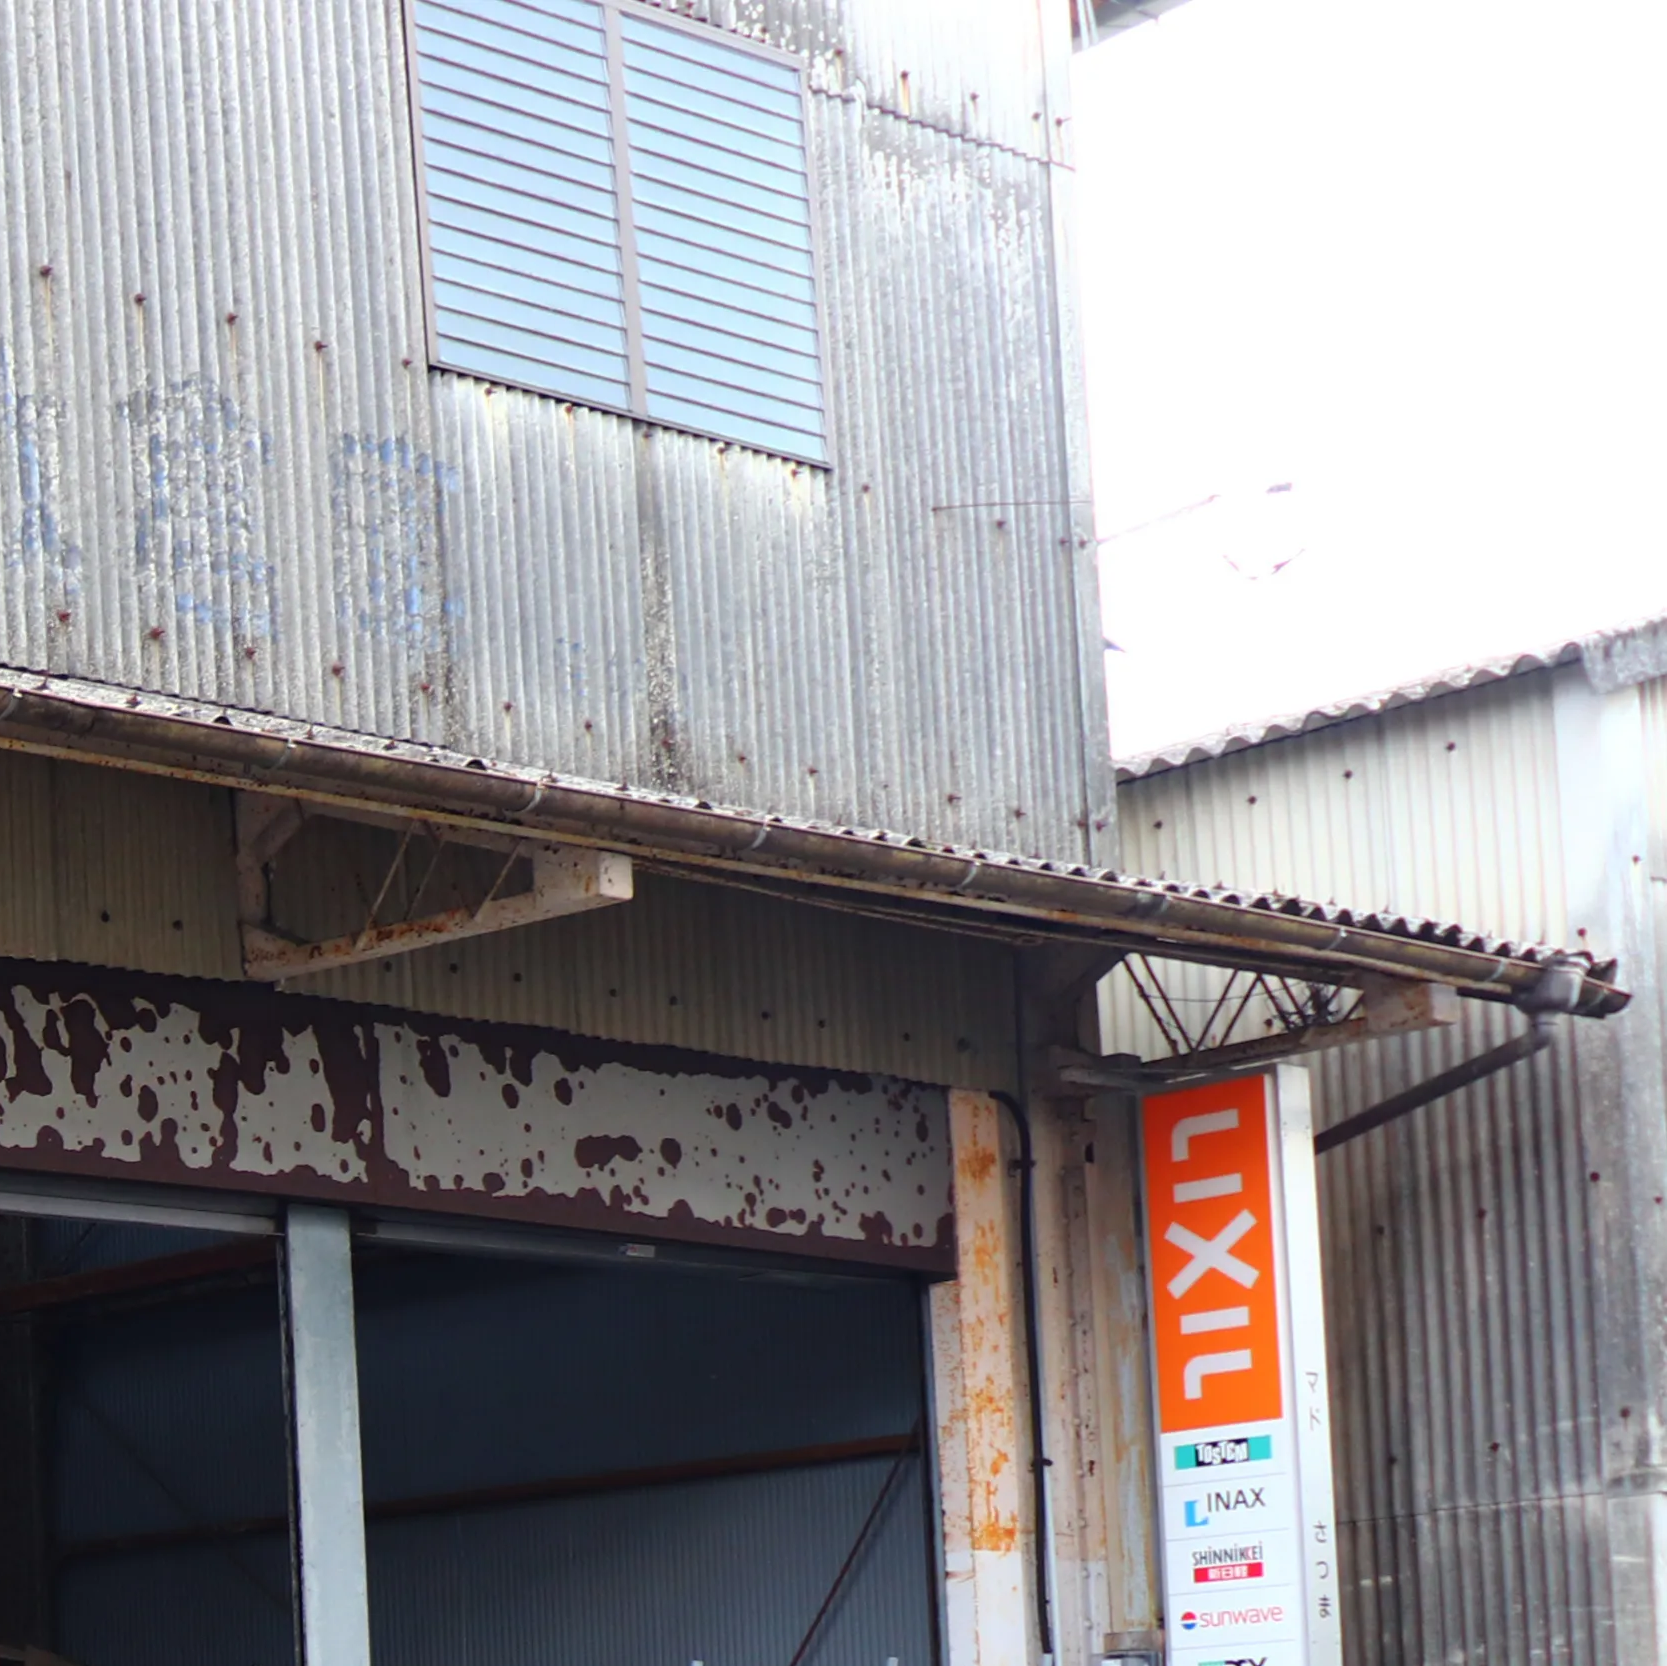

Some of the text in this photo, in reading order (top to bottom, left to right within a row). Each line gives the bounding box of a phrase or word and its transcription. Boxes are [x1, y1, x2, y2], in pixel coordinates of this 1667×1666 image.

[1164, 1108, 1261, 1401] LIXIL
[1195, 1440, 1249, 1466] TOSTEM
[1200, 1604, 1284, 1628] sunwave
